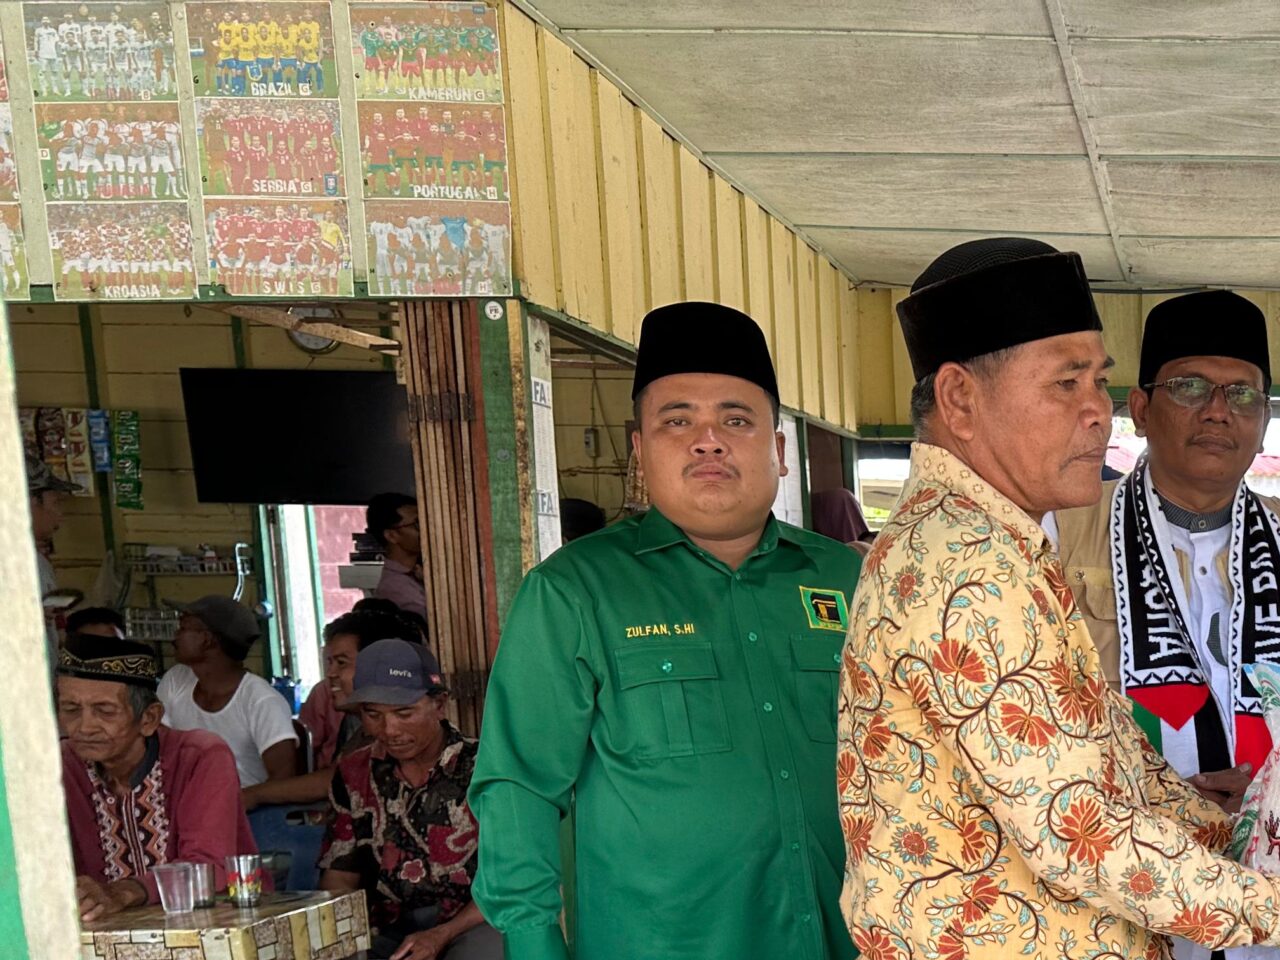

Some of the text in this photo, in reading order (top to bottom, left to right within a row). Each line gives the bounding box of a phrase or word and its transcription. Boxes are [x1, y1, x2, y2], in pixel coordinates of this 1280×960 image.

[251, 82, 296, 96] BRAZIL
[408, 87, 472, 101] KAMERUN
[252, 179, 297, 193] SERBIA
[103, 285, 161, 298] KROASIA
[263, 281, 305, 294] SWIS
[625, 624, 671, 638] ZULFAN,
